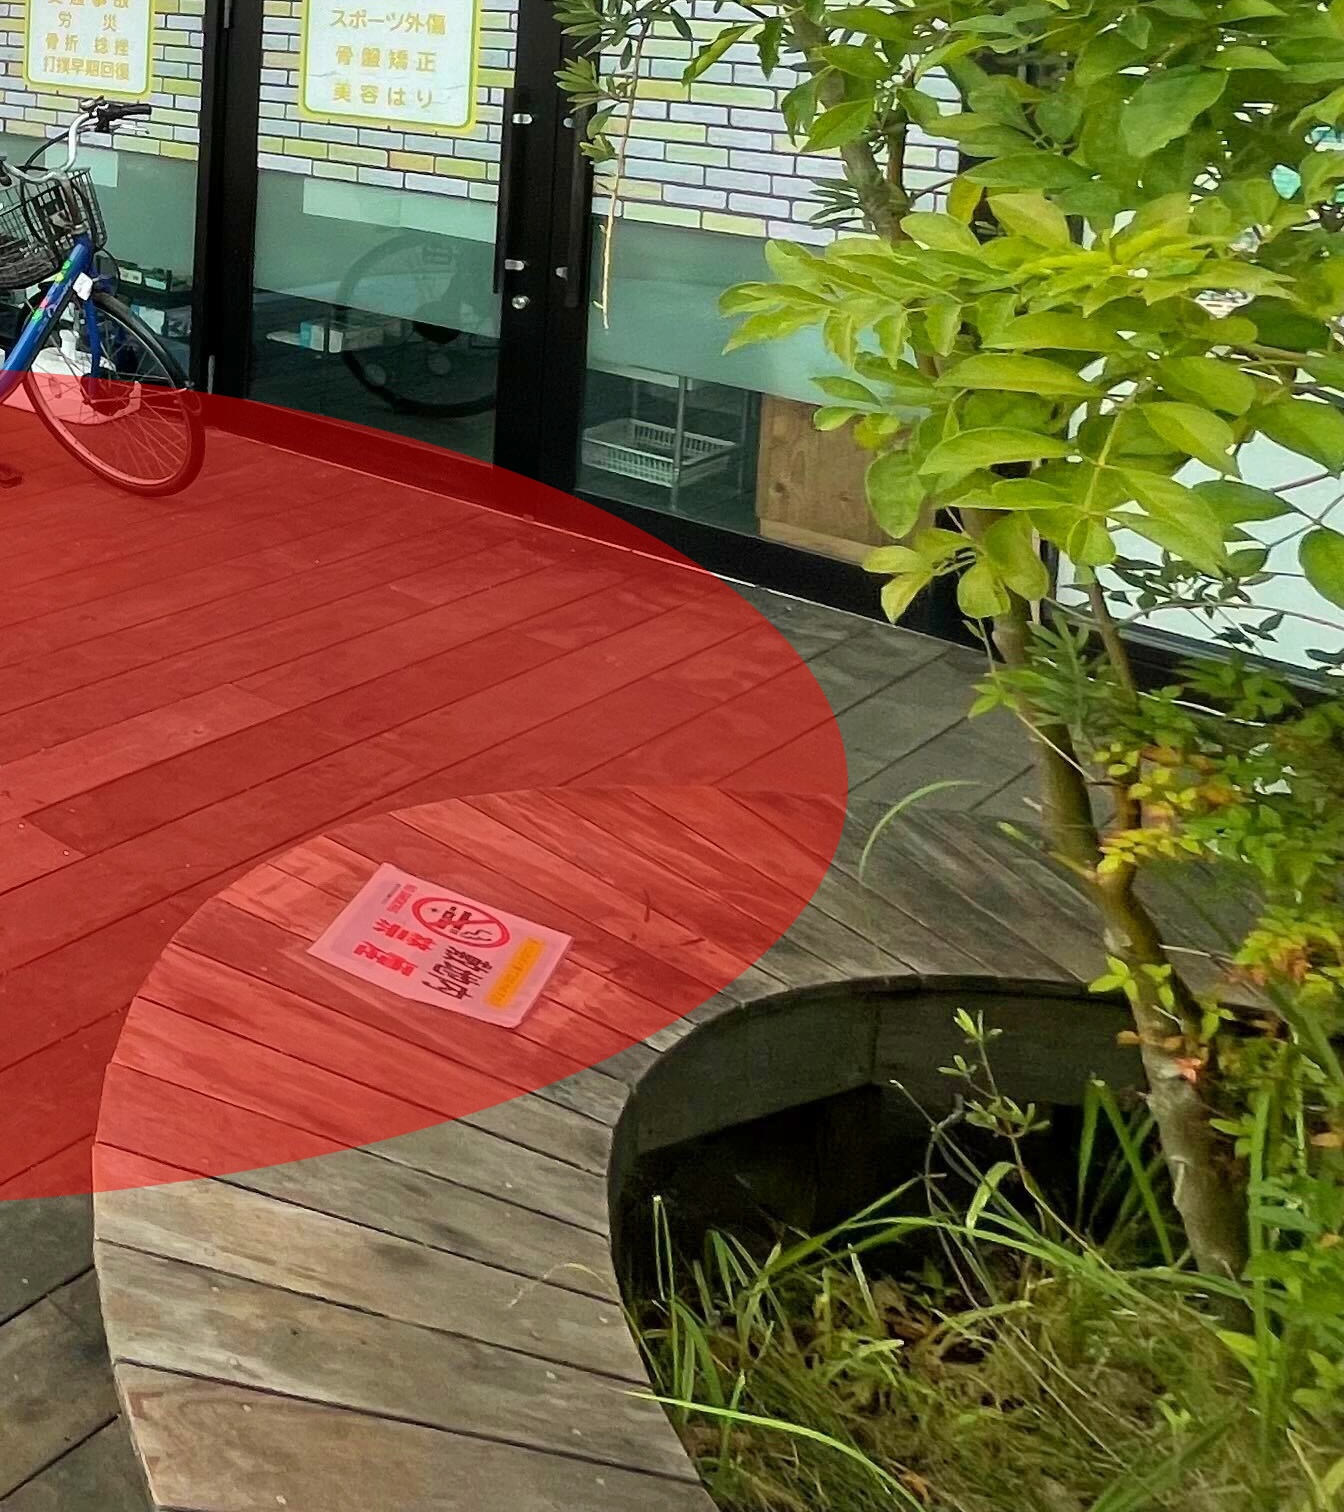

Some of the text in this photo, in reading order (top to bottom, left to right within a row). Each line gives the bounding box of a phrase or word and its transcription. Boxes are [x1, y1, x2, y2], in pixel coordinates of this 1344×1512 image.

[330, 9, 446, 35] スポーツ外傷
[336, 45, 437, 73] 骨盤矯正
[333, 83, 432, 108] 美容はり
